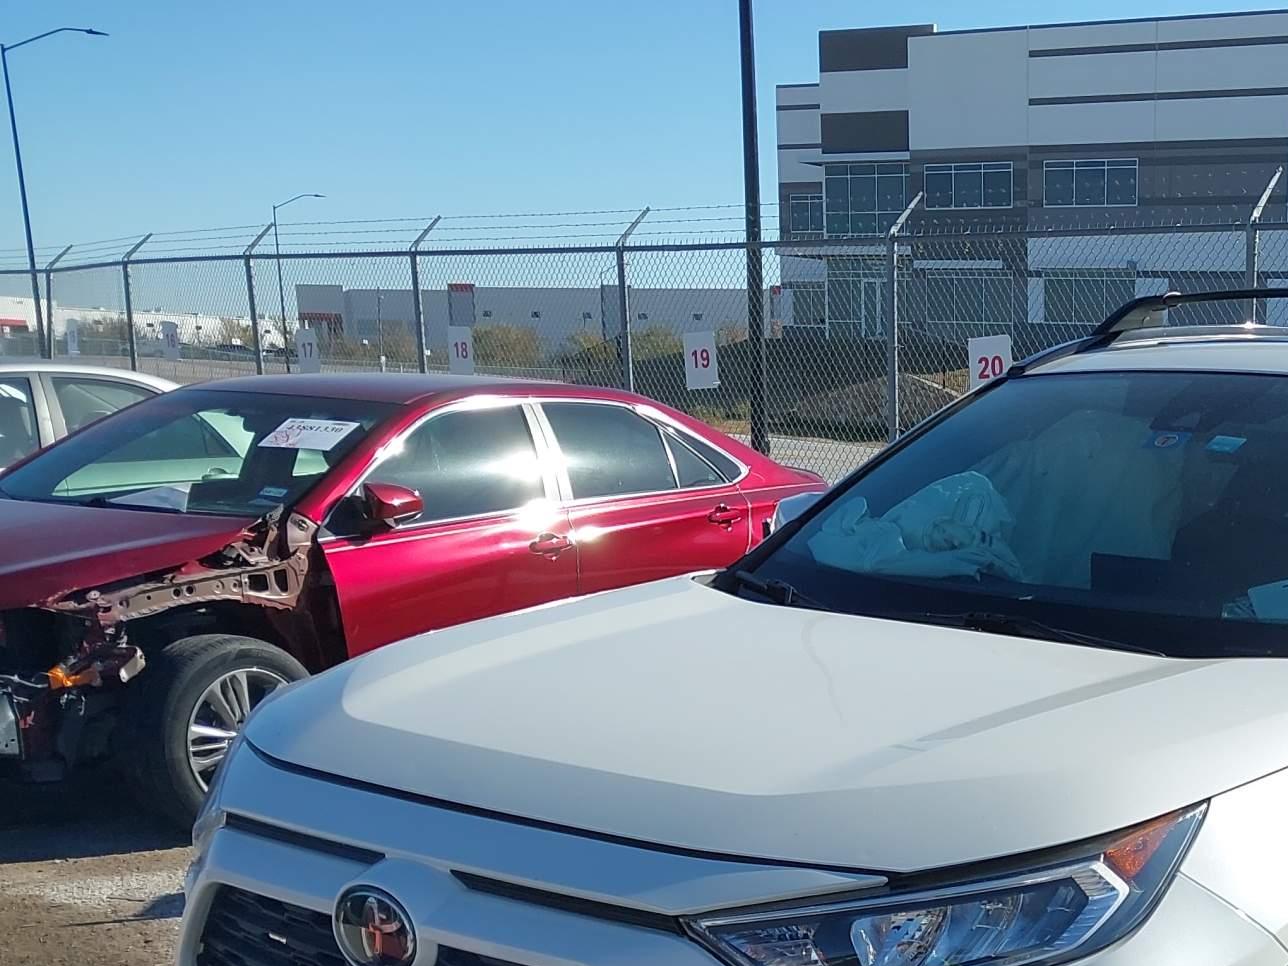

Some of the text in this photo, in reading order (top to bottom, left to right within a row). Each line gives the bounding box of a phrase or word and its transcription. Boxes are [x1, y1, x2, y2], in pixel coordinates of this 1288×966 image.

[302, 343, 314, 359] 17
[453, 341, 469, 359] 18
[691, 348, 711, 369] 19
[977, 355, 1004, 380] 20
